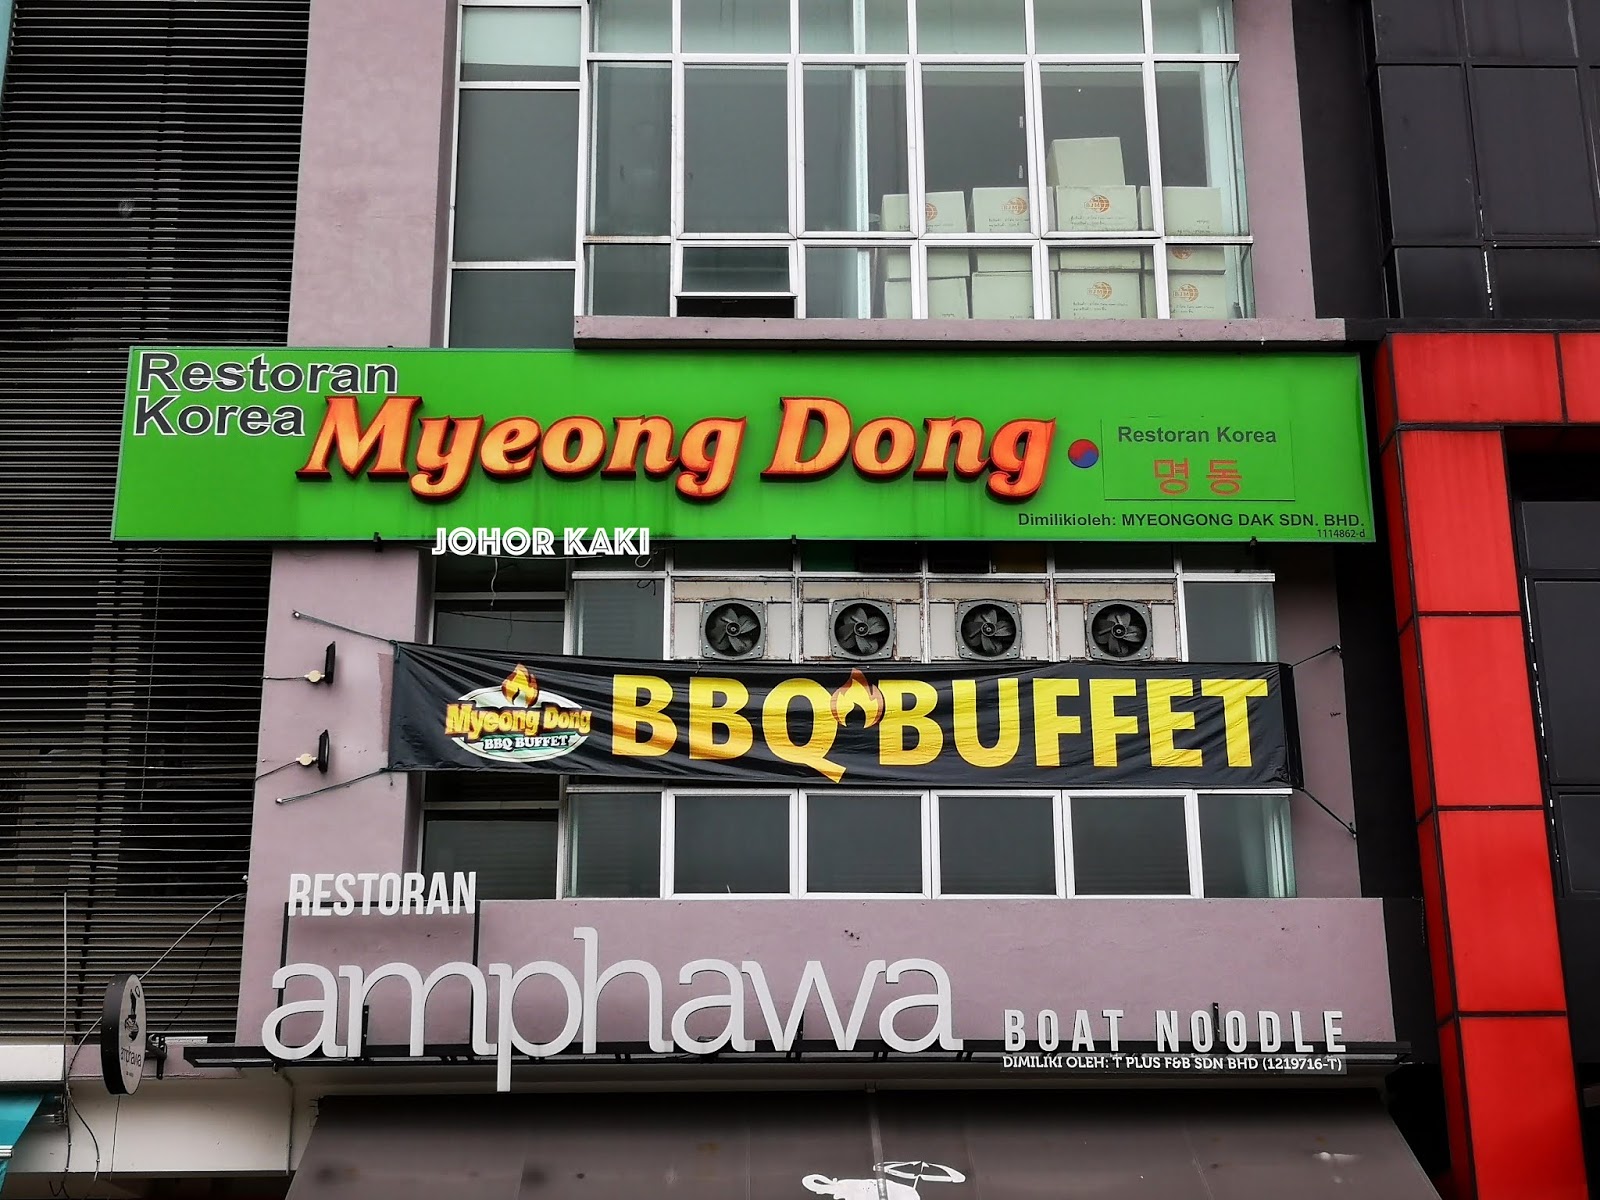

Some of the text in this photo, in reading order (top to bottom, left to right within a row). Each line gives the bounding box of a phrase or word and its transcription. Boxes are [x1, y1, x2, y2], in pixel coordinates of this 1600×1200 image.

[137, 351, 398, 393] Restoran
[133, 394, 305, 436] Korea
[1118, 426, 1277, 443] Restoran Korea
[295, 395, 1056, 501] Myeong Dong
[1018, 513, 1365, 527] Dimilikioleh: MYEONGONG DAK SDN. BHD.
[1317, 529, 1366, 538] 1114862-d
[445, 703, 593, 740] Myeong Dong
[611, 674, 1268, 784] BBQ BUFFET
[484, 735, 569, 751] BBQ BUFFET
[287, 871, 477, 916] RESTORAN
[261, 926, 963, 1092] amphawa
[1004, 1009, 1347, 1053] BOAT NOODLE
[1003, 1056, 1342, 1071] DIMILIKI OLEH: T PLUS F&B SDN BHD (1219716-T)
